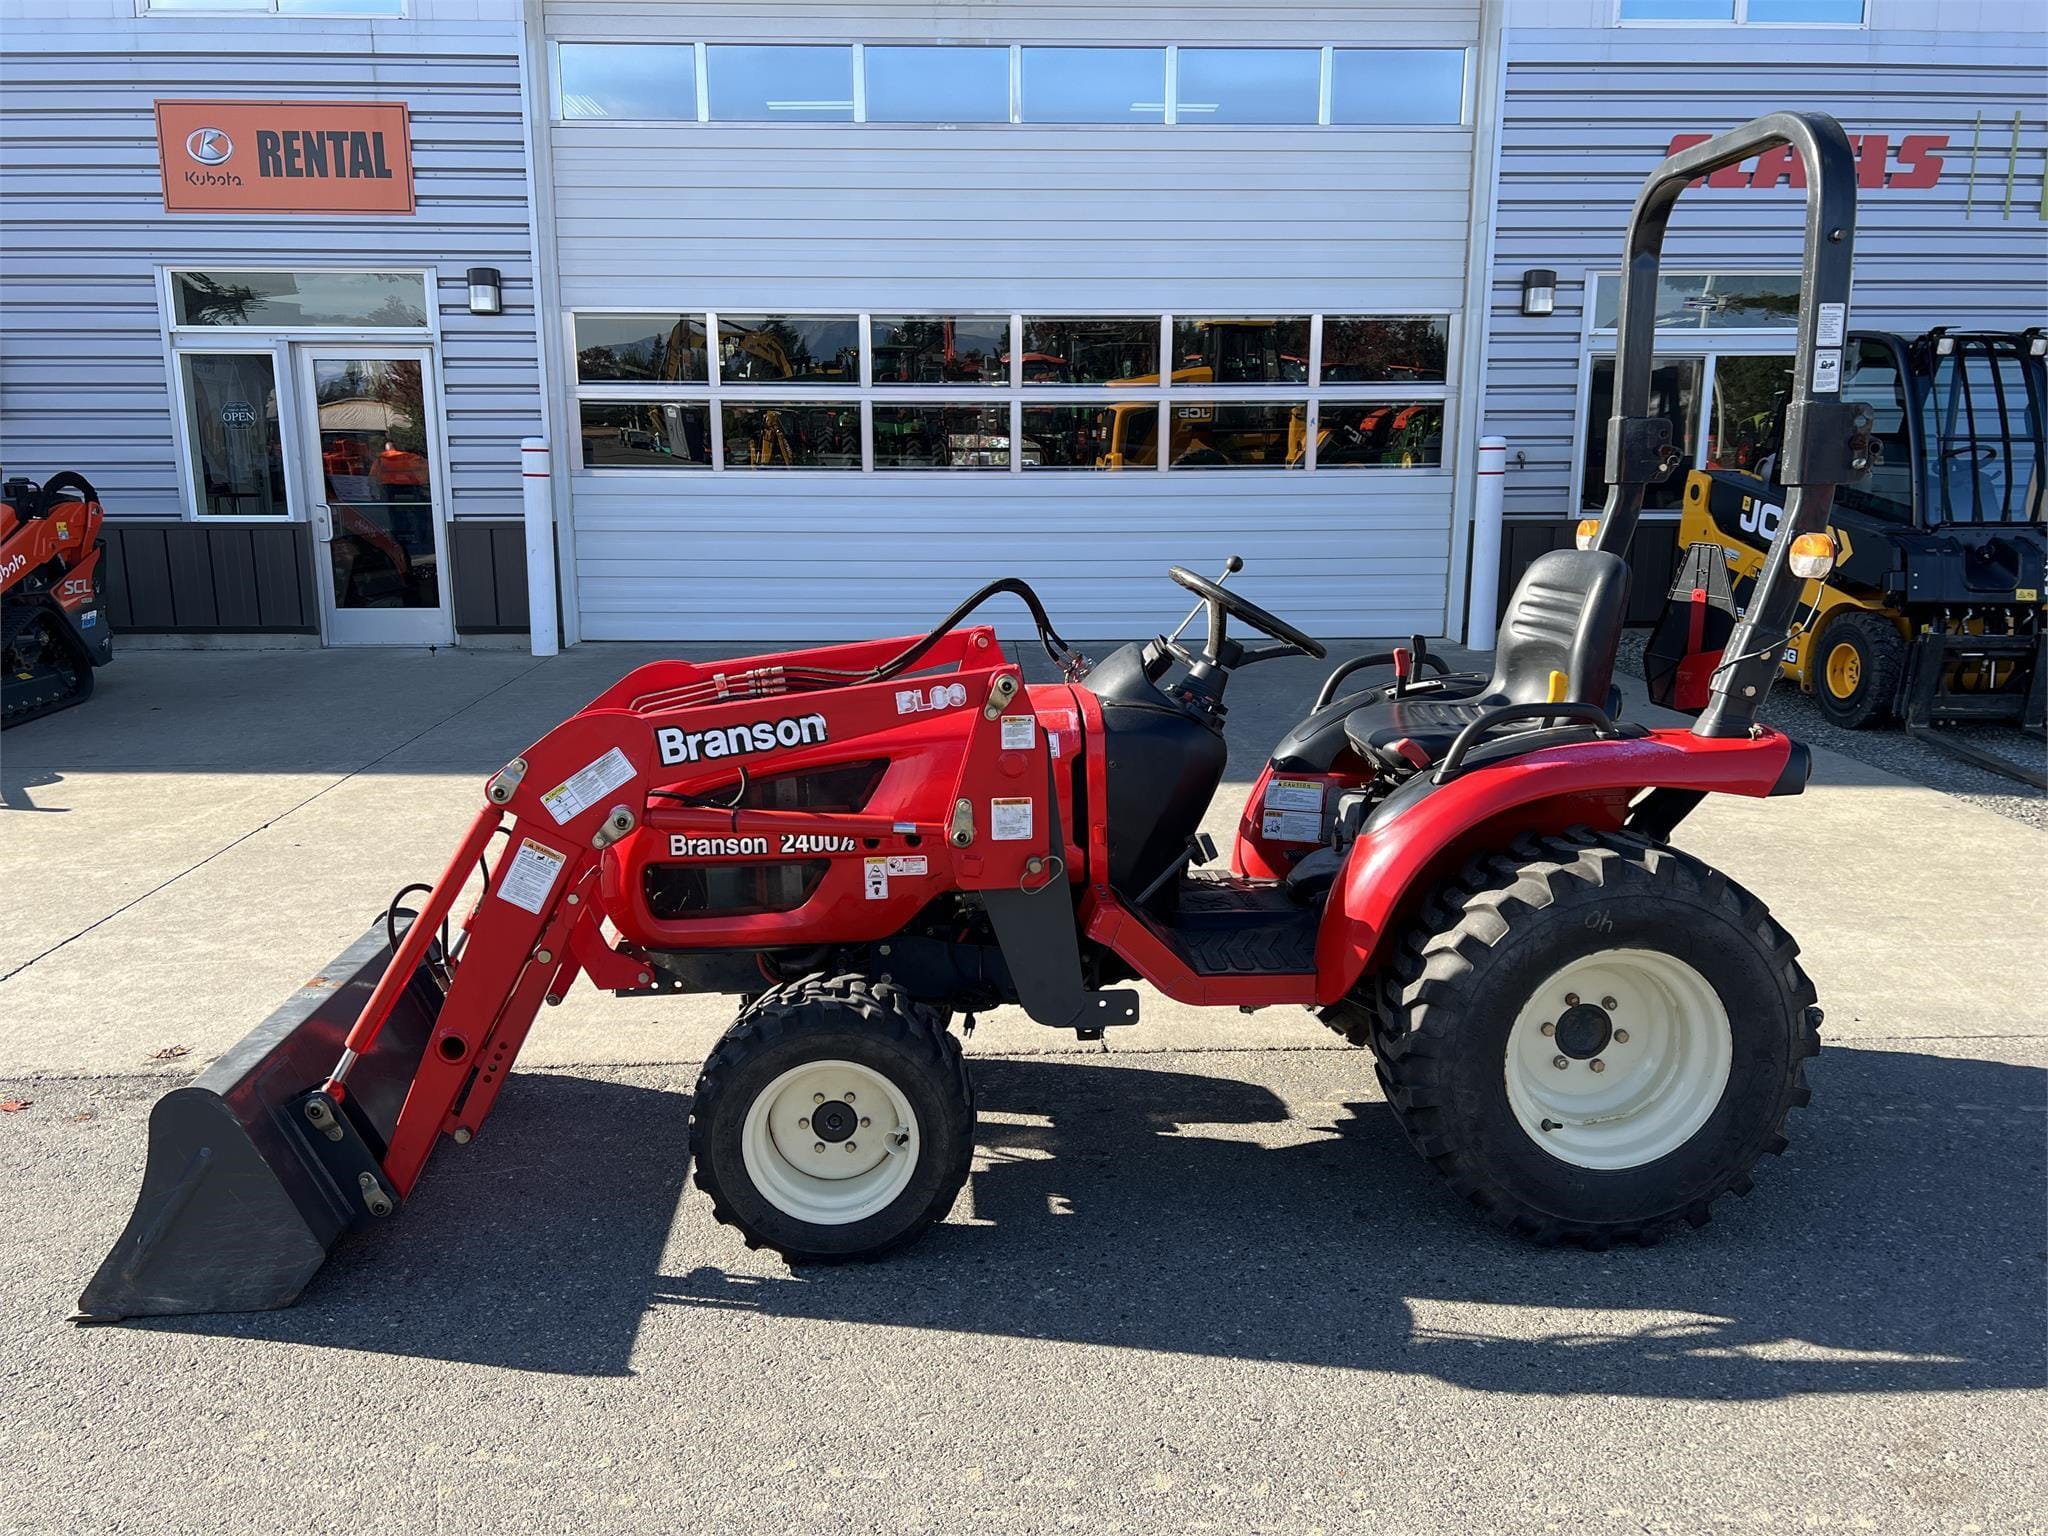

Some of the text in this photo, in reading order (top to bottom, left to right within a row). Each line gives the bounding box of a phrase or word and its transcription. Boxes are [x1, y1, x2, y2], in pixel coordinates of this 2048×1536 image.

[256, 130, 392, 179] RENTAL
[185, 171, 242, 186] Kubota
[222, 412, 255, 421] OPEN
[1740, 499, 1784, 541] JC
[64, 579, 92, 595] SCL
[656, 713, 828, 766] Branson
[669, 834, 768, 857] Branson
